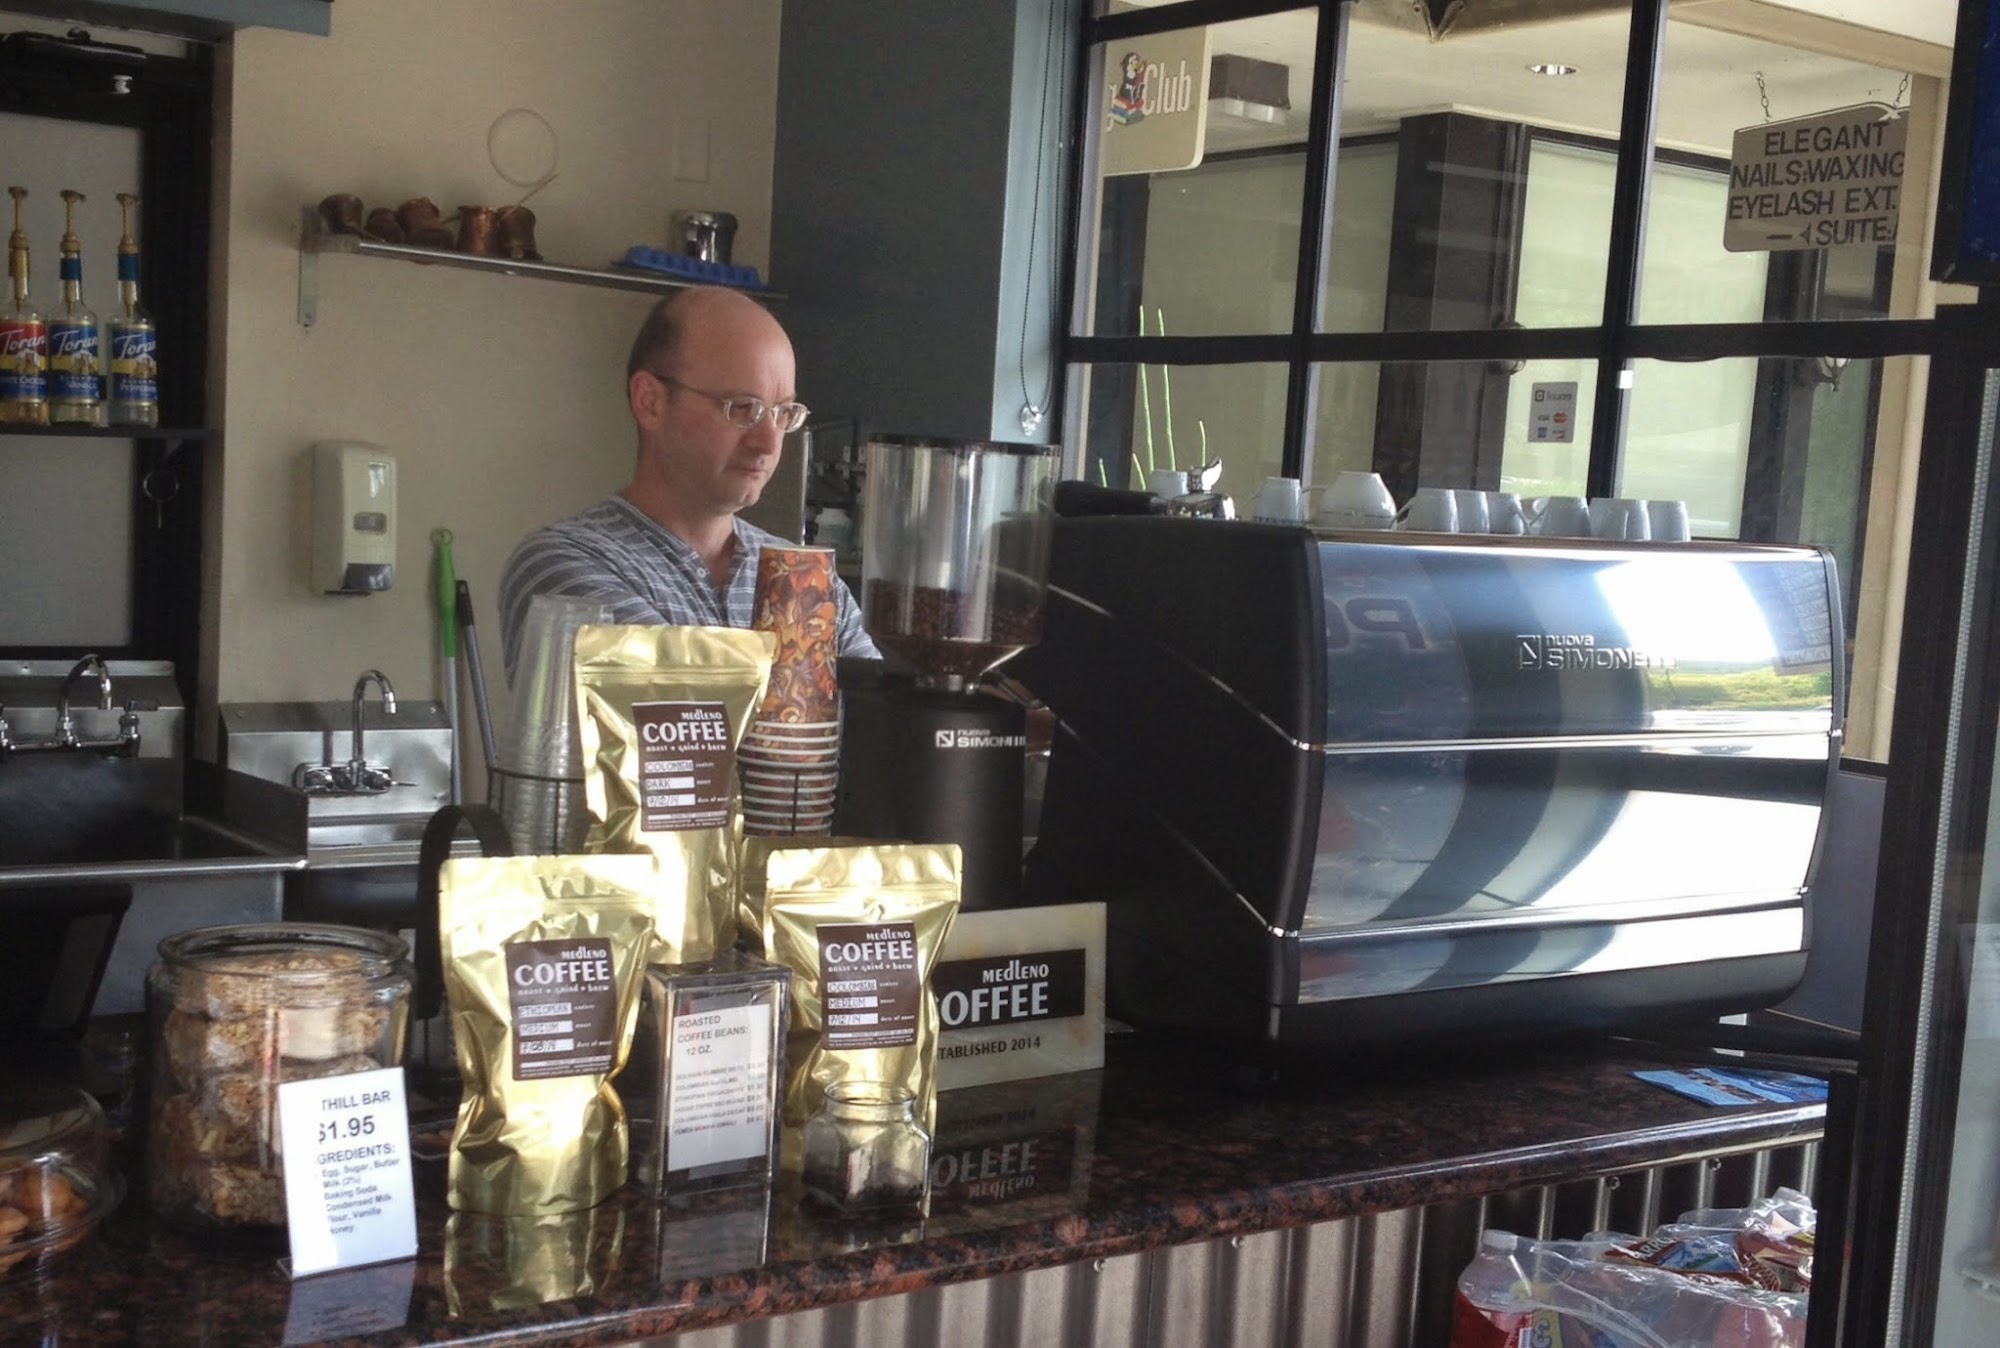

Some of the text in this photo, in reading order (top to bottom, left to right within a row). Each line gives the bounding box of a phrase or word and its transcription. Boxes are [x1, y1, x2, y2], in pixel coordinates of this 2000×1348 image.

[1142, 60, 1192, 116] Club
[1764, 121, 1890, 157] ELEGANT
[1728, 185, 1899, 220] EYELASH EXT.
[0, 329, 46, 358] Toran
[1546, 634, 1595, 646] nuova
[642, 721, 728, 743] COFFEE
[825, 940, 914, 964] COFFEE
[514, 960, 610, 986] COFFEE
[936, 981, 1049, 1026] OFFEE
[678, 1015, 721, 1028] ROASTED
[677, 1026, 749, 1043] COFFEE BEANS:
[686, 1047, 697, 1056] 12
[937, 1036, 1041, 1060] TABLISHED 2014
[321, 1090, 391, 1111] THILL BAR
[317, 1143, 396, 1165] GREDIENTS:
